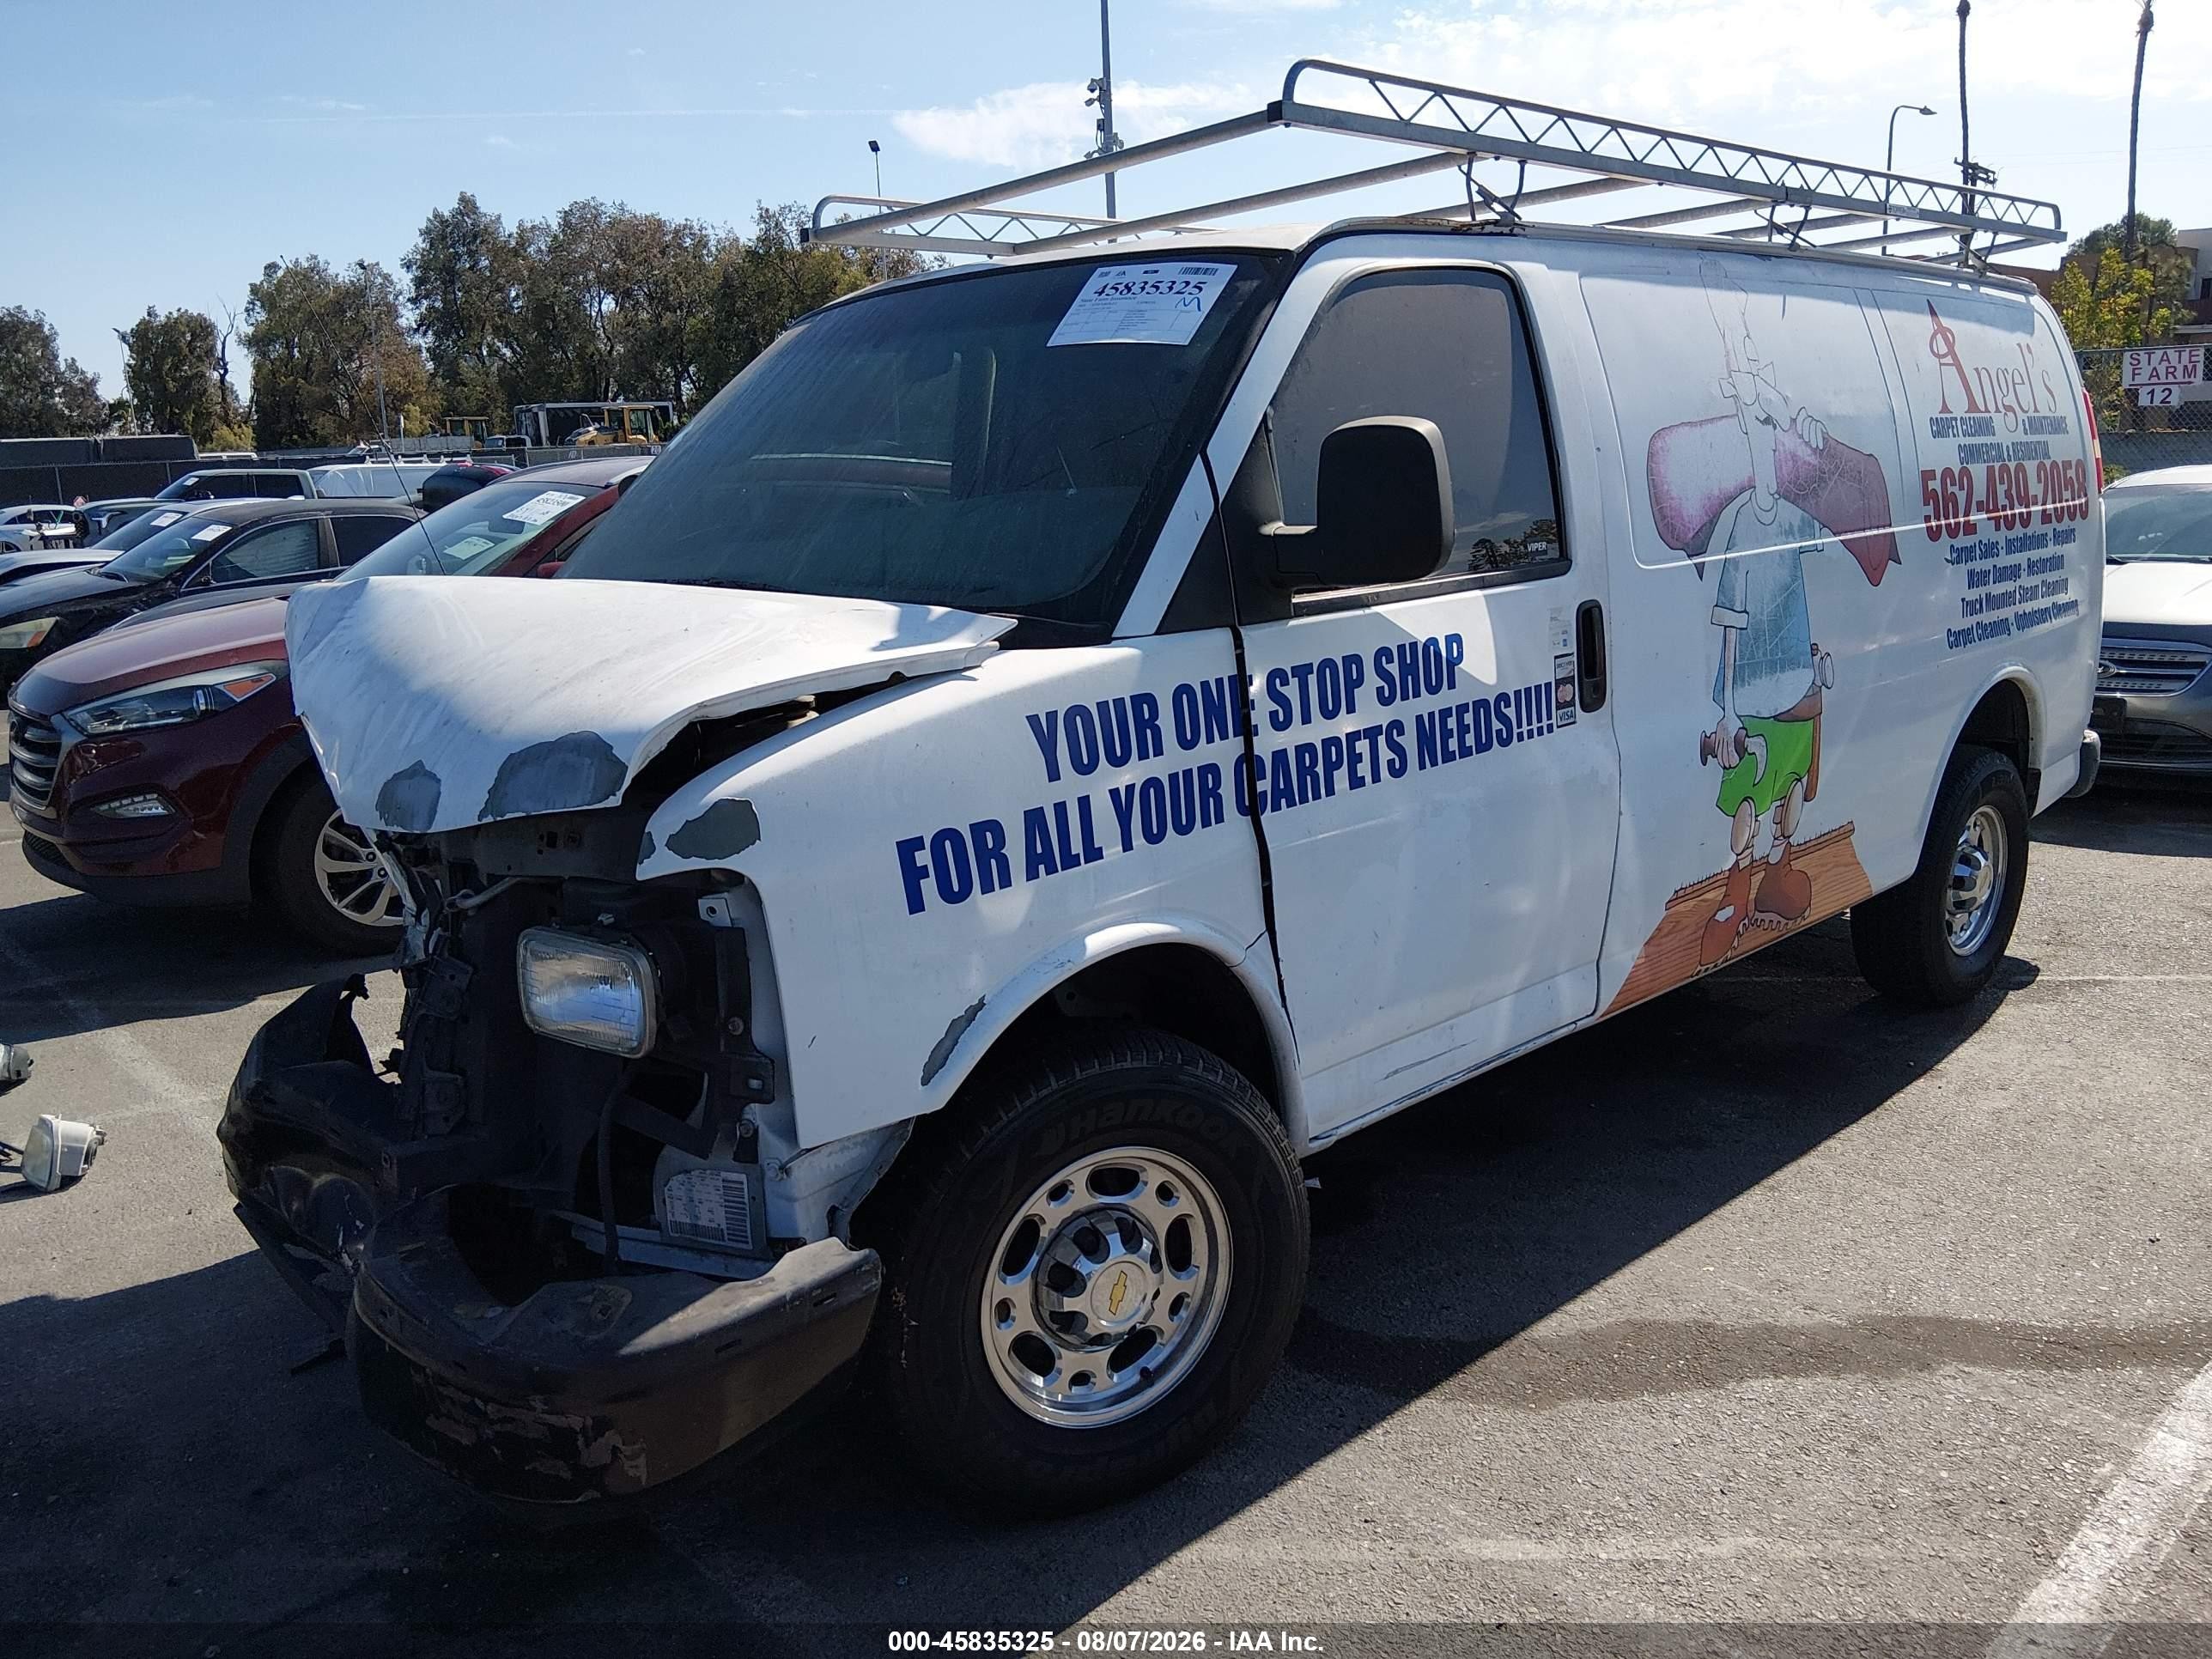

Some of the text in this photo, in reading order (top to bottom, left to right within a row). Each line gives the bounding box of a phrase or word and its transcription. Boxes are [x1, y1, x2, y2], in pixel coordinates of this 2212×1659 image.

[1094, 280, 1207, 297] 45835325
[1927, 298, 2057, 433] Angel's
[2130, 349, 2200, 366] STATE
[2132, 364, 2197, 381] FARM
[2147, 388, 2172, 404] 12
[1929, 416, 2069, 439] CARPET CLEANING & MAINTENANCE
[1958, 441, 2051, 465] COMMERCIAL & RESIDENTIAL
[1921, 459, 2088, 543] 562-439-2058
[1528, 542, 1547, 551] VIPER
[1949, 541, 1977, 566] Carpet
[1978, 539, 1999, 559] Sales
[2005, 532, 2048, 556] Installations
[2053, 527, 2075, 547] Repairs
[1967, 568, 1990, 590] Water
[1992, 562, 2021, 583] Damage
[2027, 554, 2064, 577] Restoration
[1960, 576, 2069, 618] Truck Mounted Steam Cleaning
[1947, 623, 1976, 649] Carpet
[1976, 617, 2011, 641] Cleaning
[2014, 606, 2051, 633] Upholstery
[2051, 598, 2079, 619] Cleaning
[1025, 632, 1463, 782] YOUR ONE STOP SHOP
[1559, 711, 1574, 722] VISA
[896, 681, 1554, 915] FOR ALL YOUR CARPETS NEEDS!!!!
